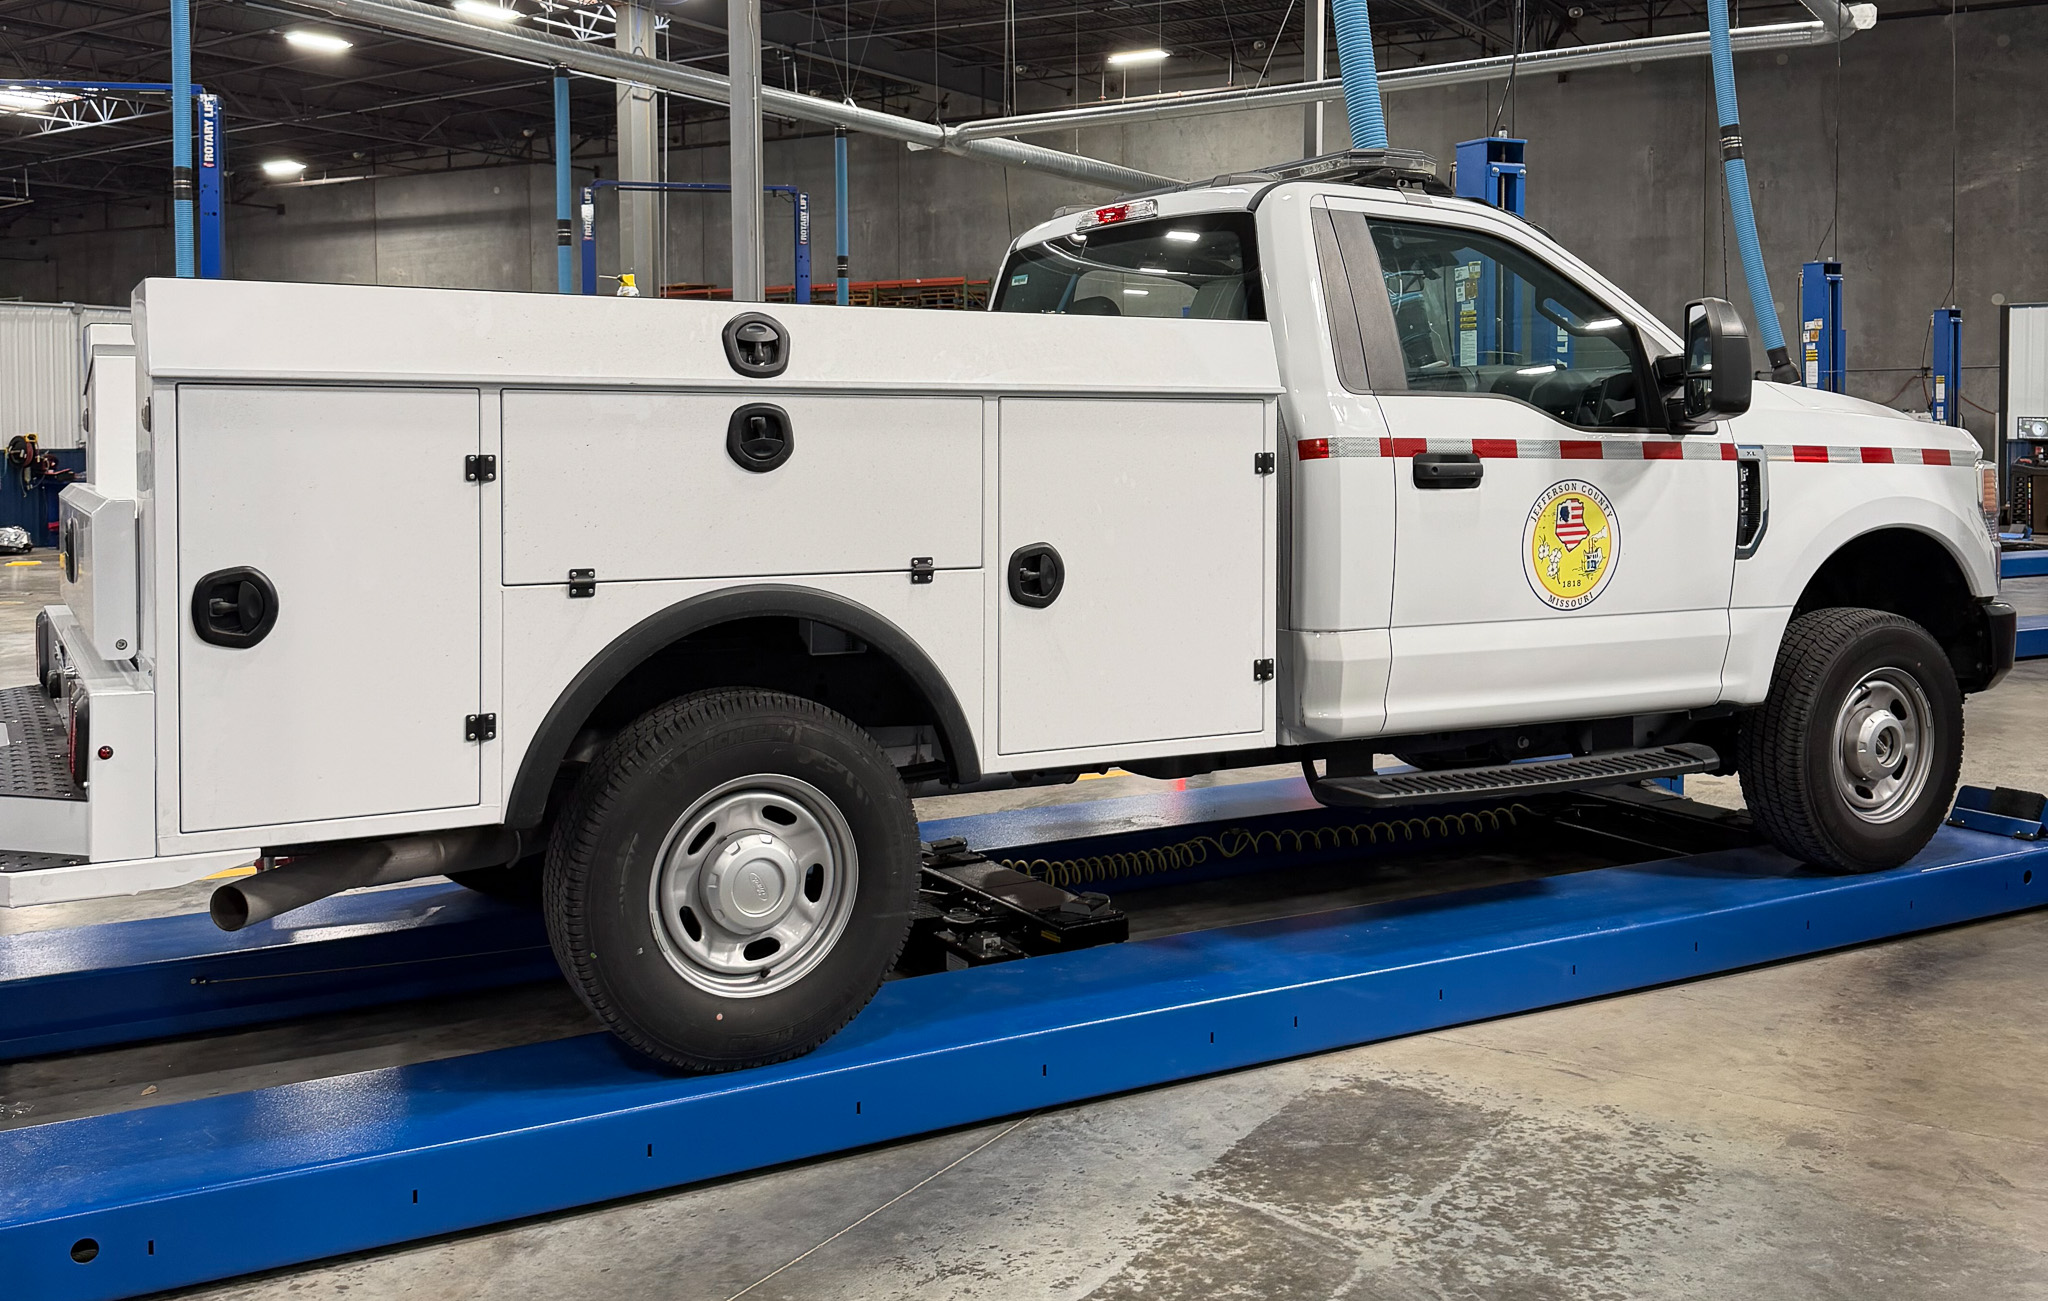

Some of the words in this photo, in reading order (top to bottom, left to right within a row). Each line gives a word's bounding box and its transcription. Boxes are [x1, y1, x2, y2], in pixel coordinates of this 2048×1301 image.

[204, 120, 214, 161] ROTARY
[1530, 483, 1577, 522] JEFFERSON
[1581, 485, 1614, 518] COUNTY
[1562, 580, 1582, 588] 1818
[1548, 592, 1594, 607] MISSOURI
